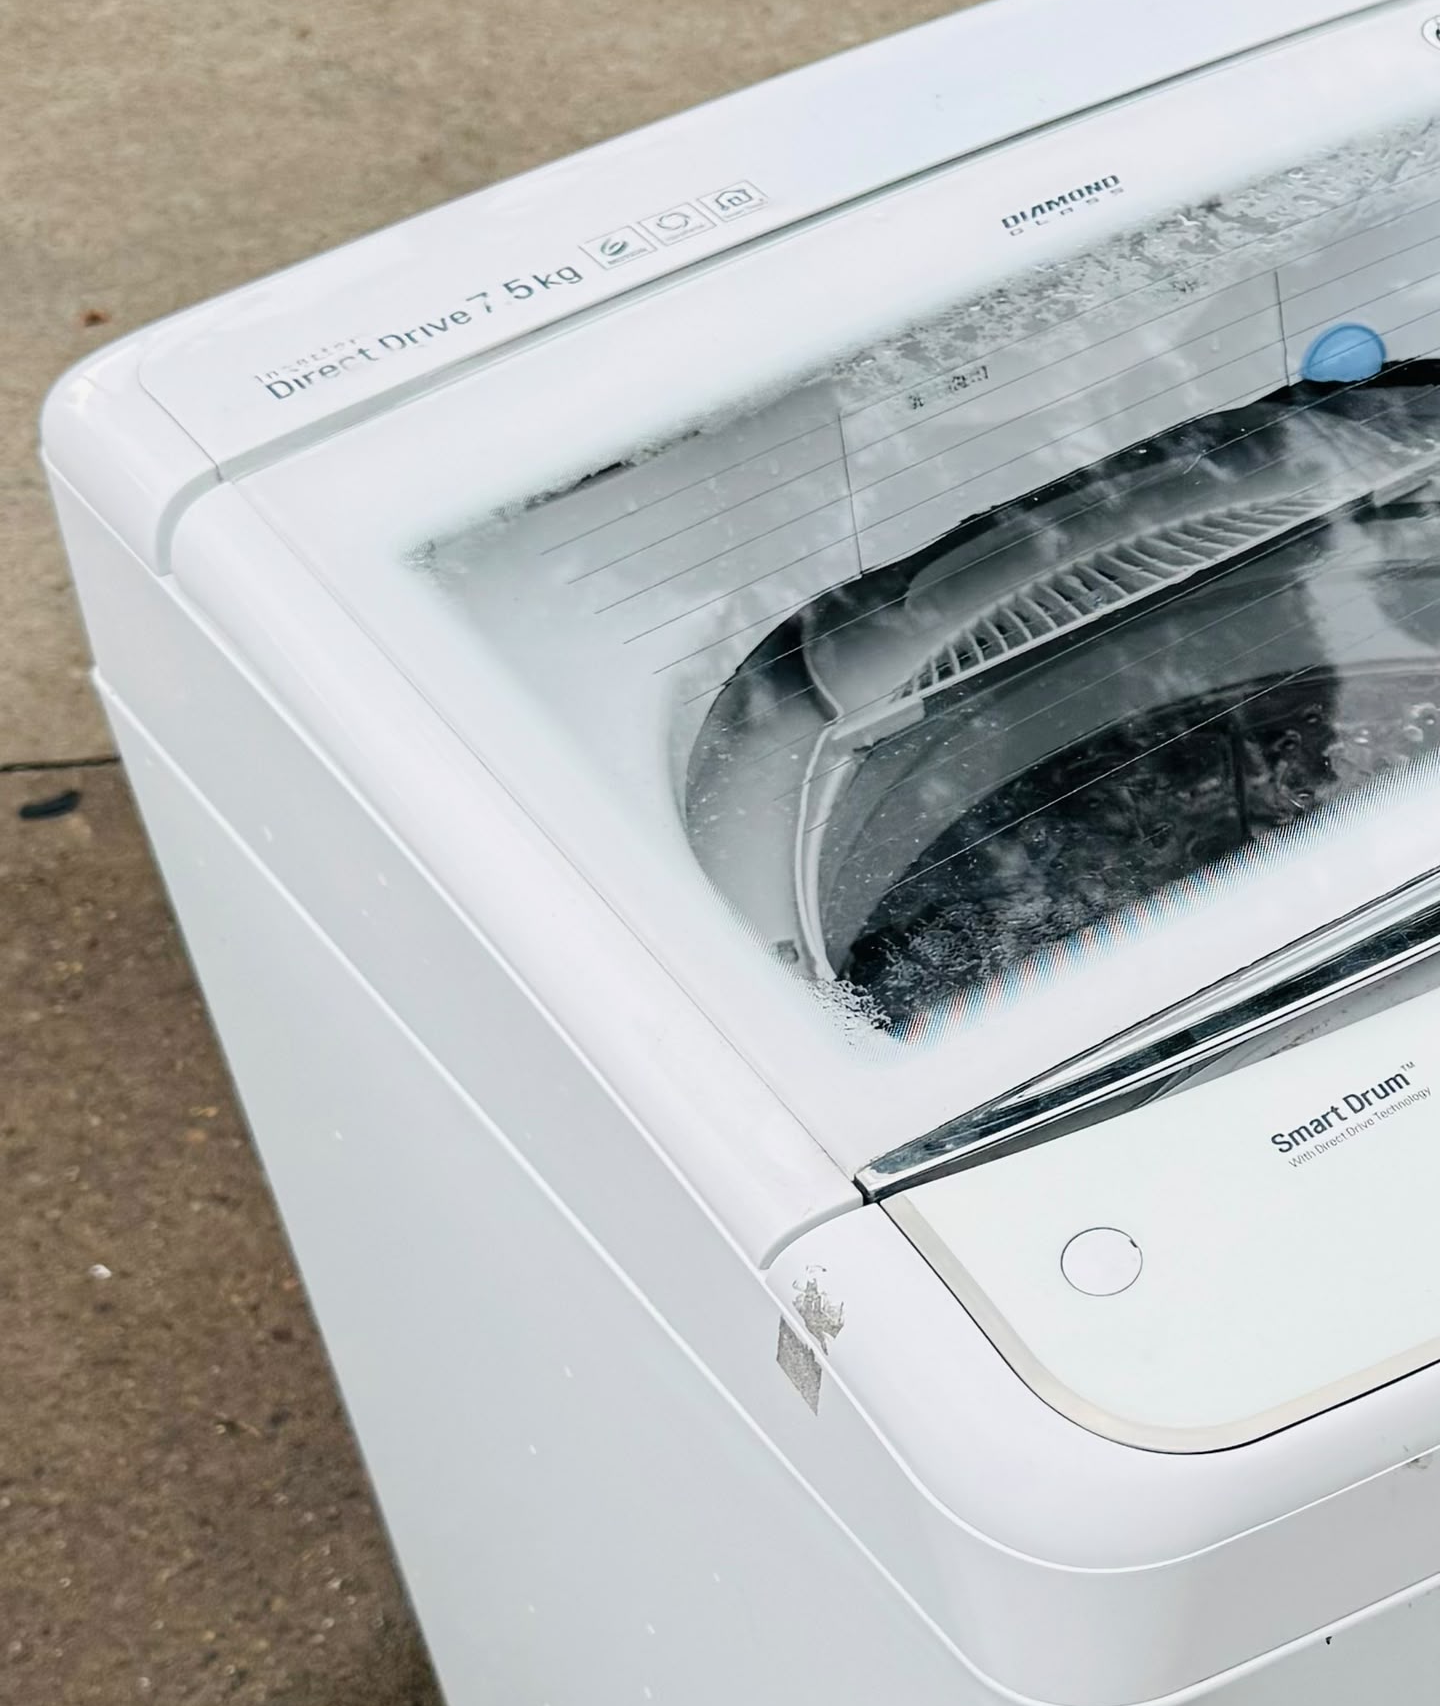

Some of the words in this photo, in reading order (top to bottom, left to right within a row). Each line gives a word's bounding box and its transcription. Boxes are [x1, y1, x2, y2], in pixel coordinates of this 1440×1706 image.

[1001, 174, 1120, 230] DIAMOND
[265, 348, 379, 400] Direct
[378, 309, 472, 351] Drive
[1270, 1105, 1349, 1153] Smart
[1288, 1149, 1317, 1169] With
[1314, 1131, 1350, 1155] Direct
[1345, 1117, 1376, 1138] Drive
[1373, 1085, 1433, 1122] Technology
